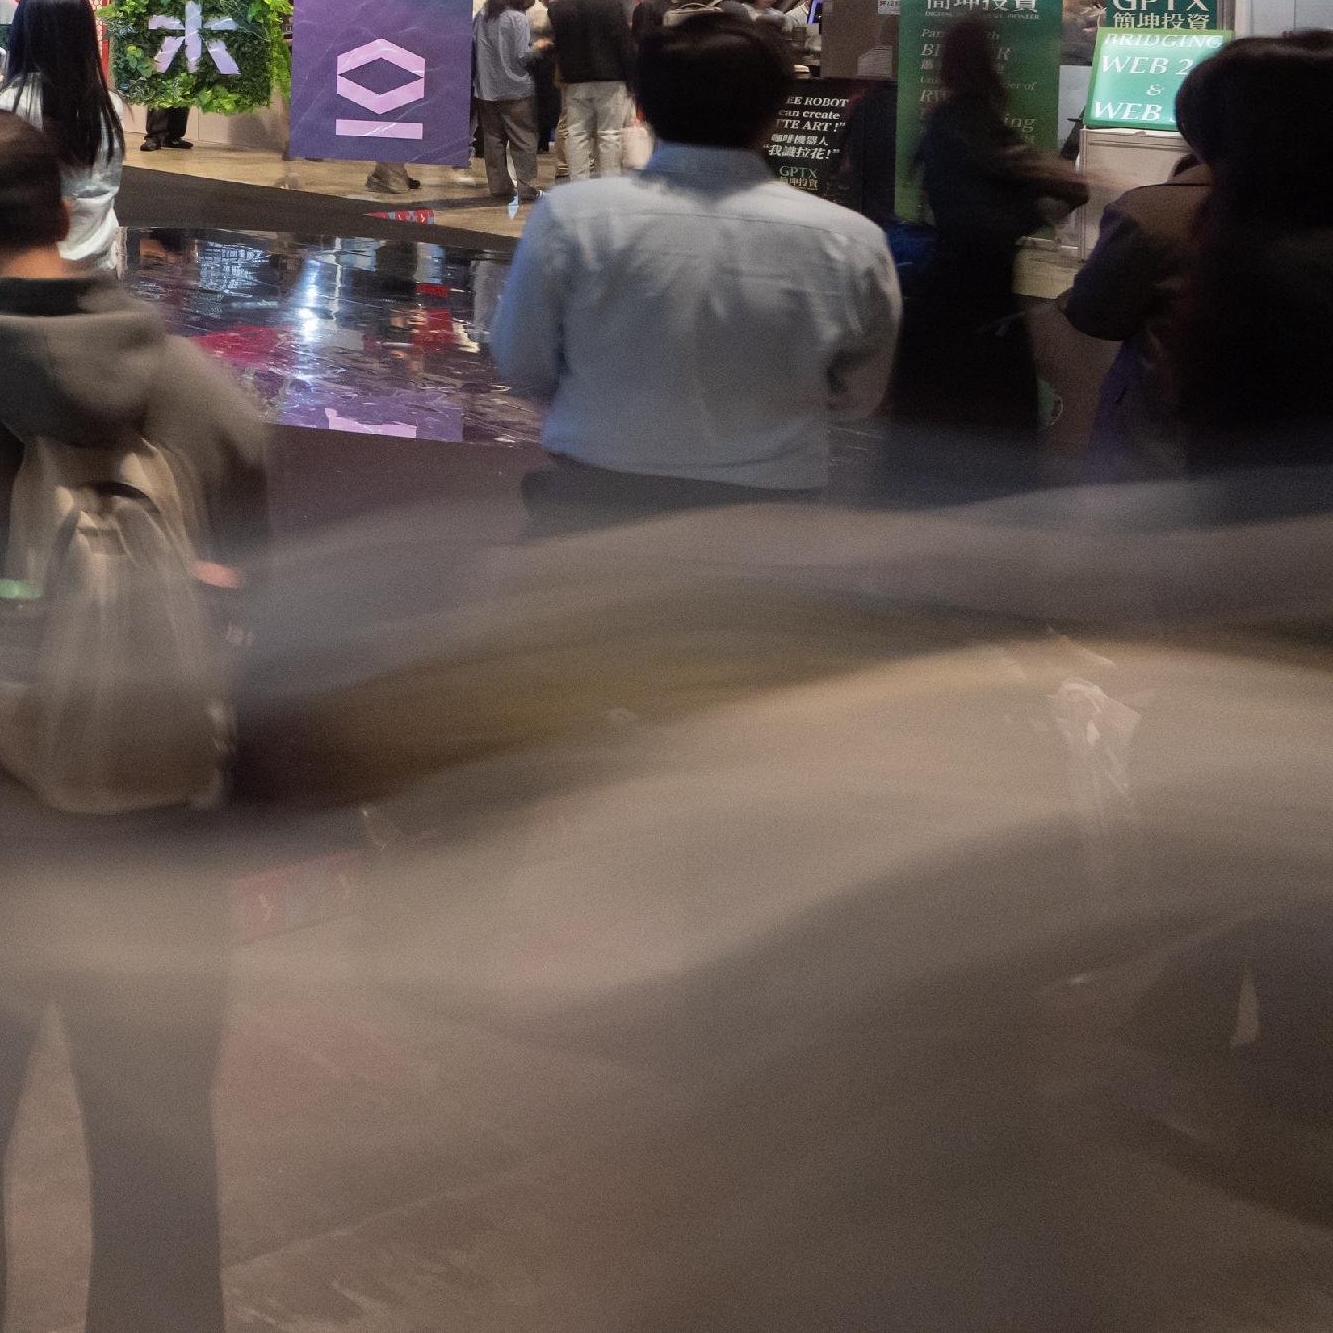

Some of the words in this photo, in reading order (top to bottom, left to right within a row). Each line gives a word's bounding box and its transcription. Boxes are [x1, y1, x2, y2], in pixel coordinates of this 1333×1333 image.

[1113, 12, 1210, 30] 簡坤投資
[1103, 33, 1224, 49] BRIDGING
[1100, 54, 1170, 76] WEB
[1146, 84, 1165, 96] &
[804, 97, 849, 107] ROBOT
[778, 109, 799, 117] can
[803, 111, 840, 120] create
[1093, 101, 1162, 122] WEB
[779, 165, 817, 178] GPTX
